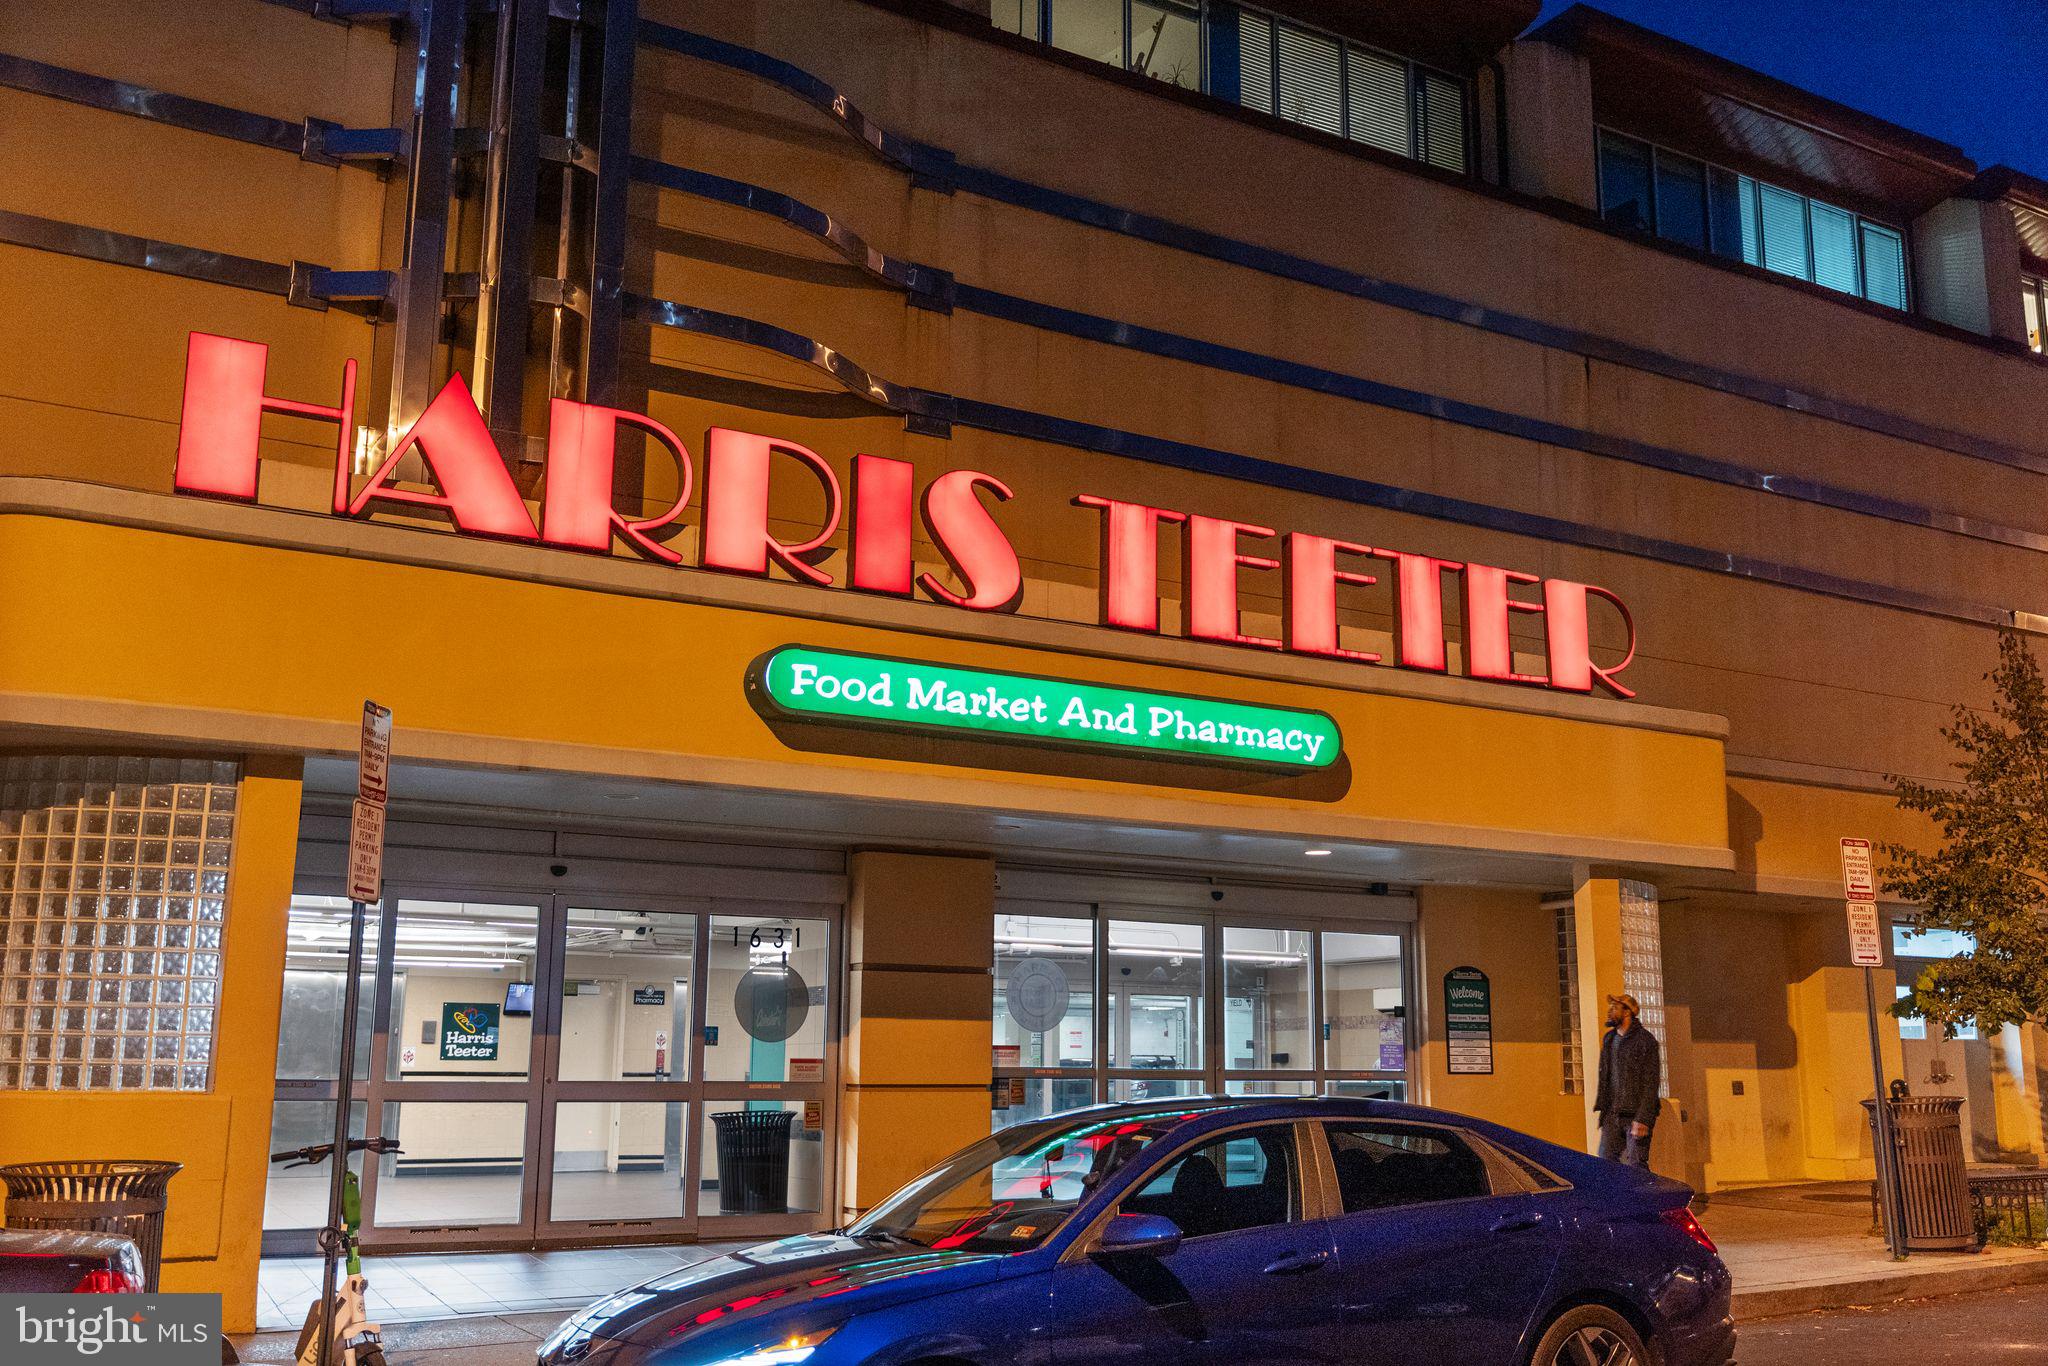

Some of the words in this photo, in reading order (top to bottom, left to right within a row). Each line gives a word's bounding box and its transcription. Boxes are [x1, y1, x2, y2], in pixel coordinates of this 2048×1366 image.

[174, 330, 1021, 612] HARRIS
[1072, 494, 1636, 699] TEETER
[790, 663, 892, 707] Food
[906, 677, 1048, 725] Market
[1058, 696, 1137, 735] And
[1148, 706, 1325, 763] Pharmacy
[359, 807, 375, 820] ZONE
[356, 818, 380, 833] RESIDENT
[359, 830, 376, 843] PERMIT
[355, 841, 379, 856] PARKING
[360, 853, 372, 865] ONLY
[733, 926, 800, 948] 1631
[1450, 986, 1485, 1000] Welcome
[446, 1031, 494, 1044] Harris
[445, 1044, 493, 1057] Teeter
